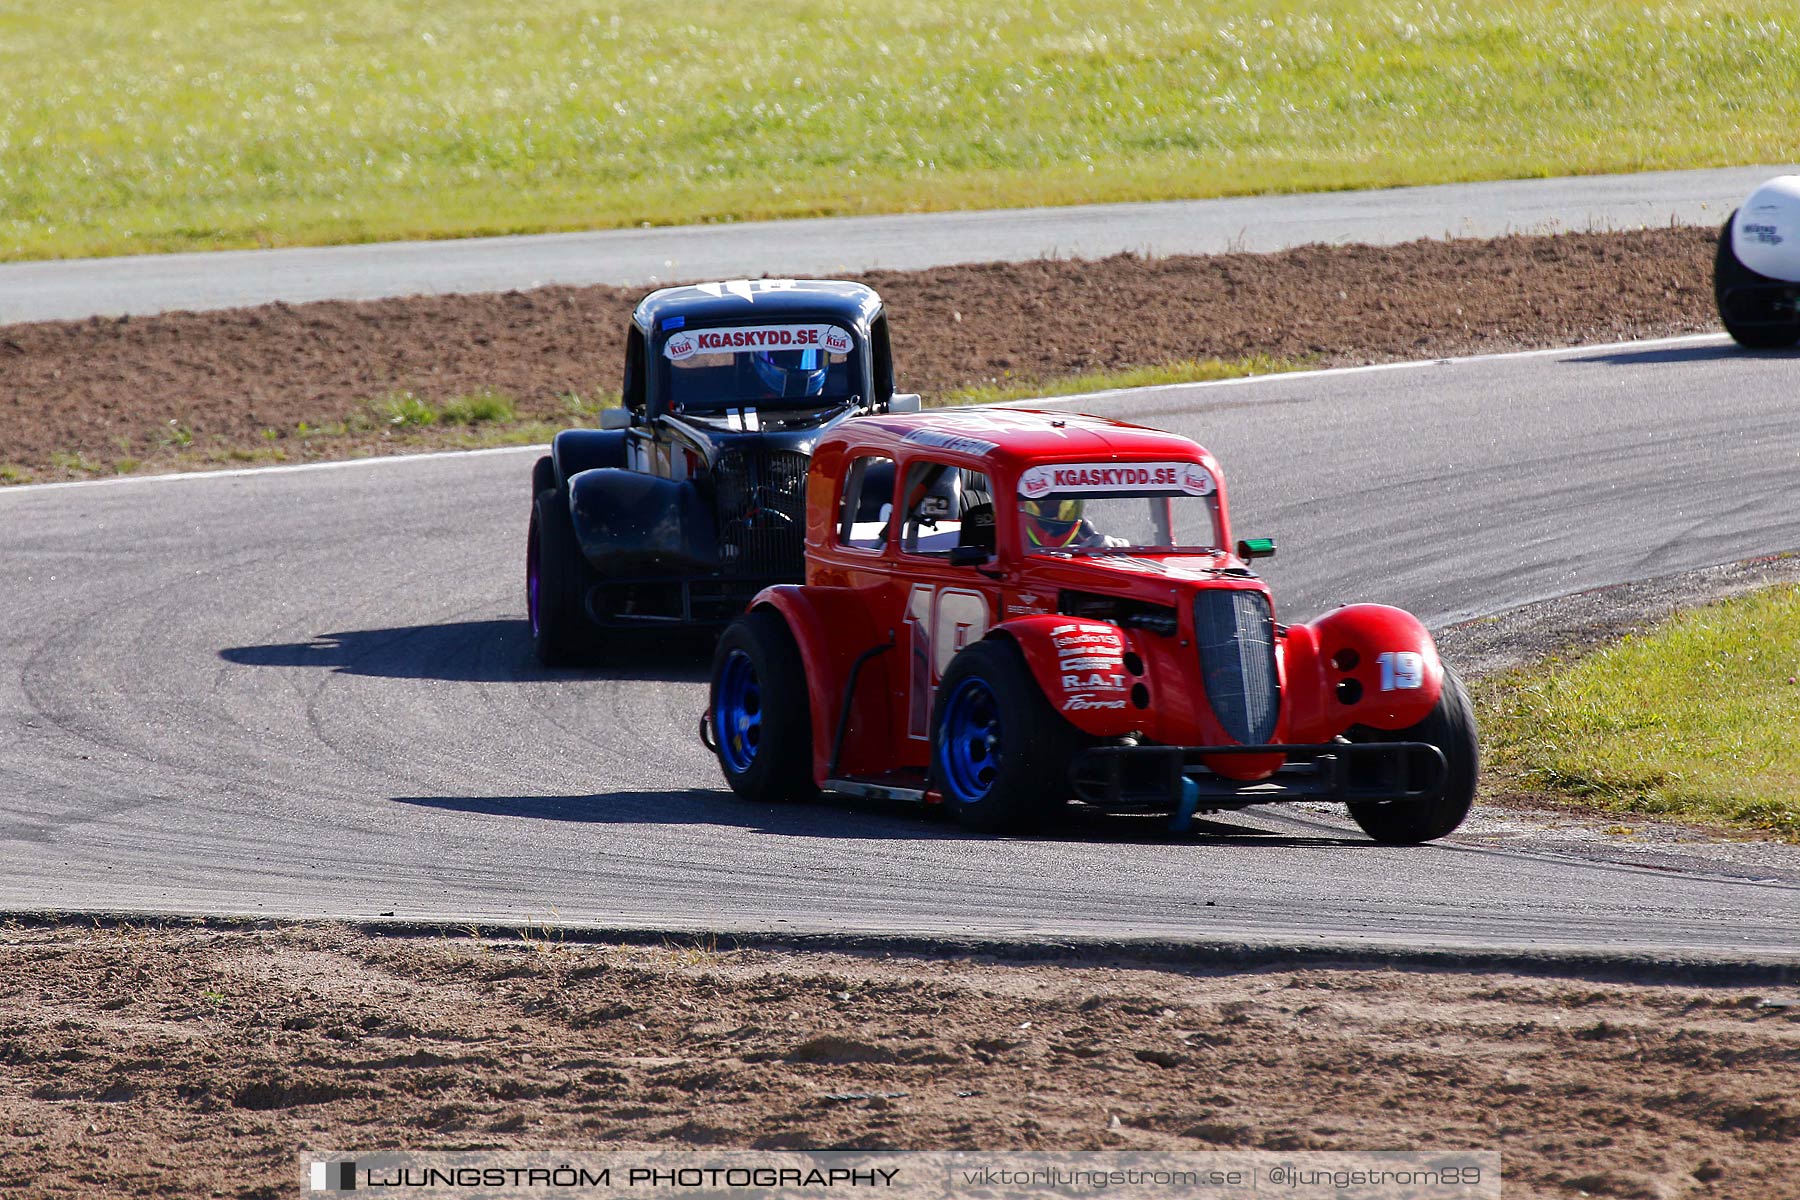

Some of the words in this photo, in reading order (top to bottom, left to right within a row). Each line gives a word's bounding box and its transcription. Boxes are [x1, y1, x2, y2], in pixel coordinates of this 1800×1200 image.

[698, 329, 819, 349] KGASKYDD.SE
[826, 335, 847, 349] KGA
[1054, 468, 1176, 486] KGASKYDD.SE
[1376, 651, 1424, 692] 19
